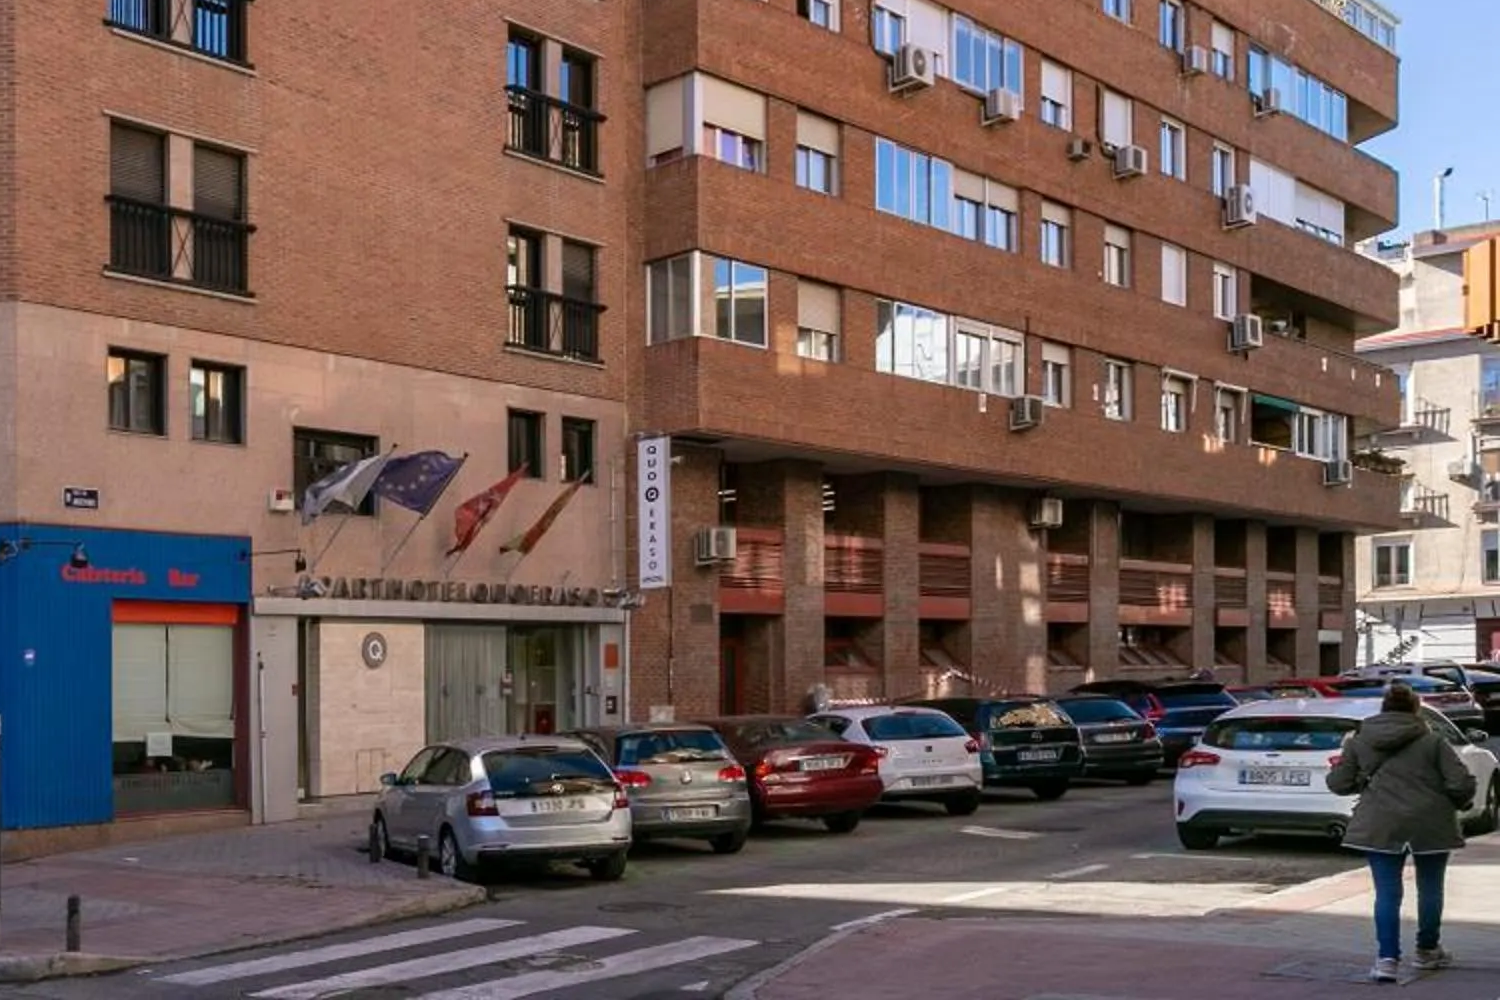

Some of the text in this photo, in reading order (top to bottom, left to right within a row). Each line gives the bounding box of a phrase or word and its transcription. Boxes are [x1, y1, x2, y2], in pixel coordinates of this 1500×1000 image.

[645, 445, 657, 482] QUO
[647, 508, 657, 571] ERASO
[168, 568, 200, 588] Bar
[527, 585, 601, 607] ERASO
